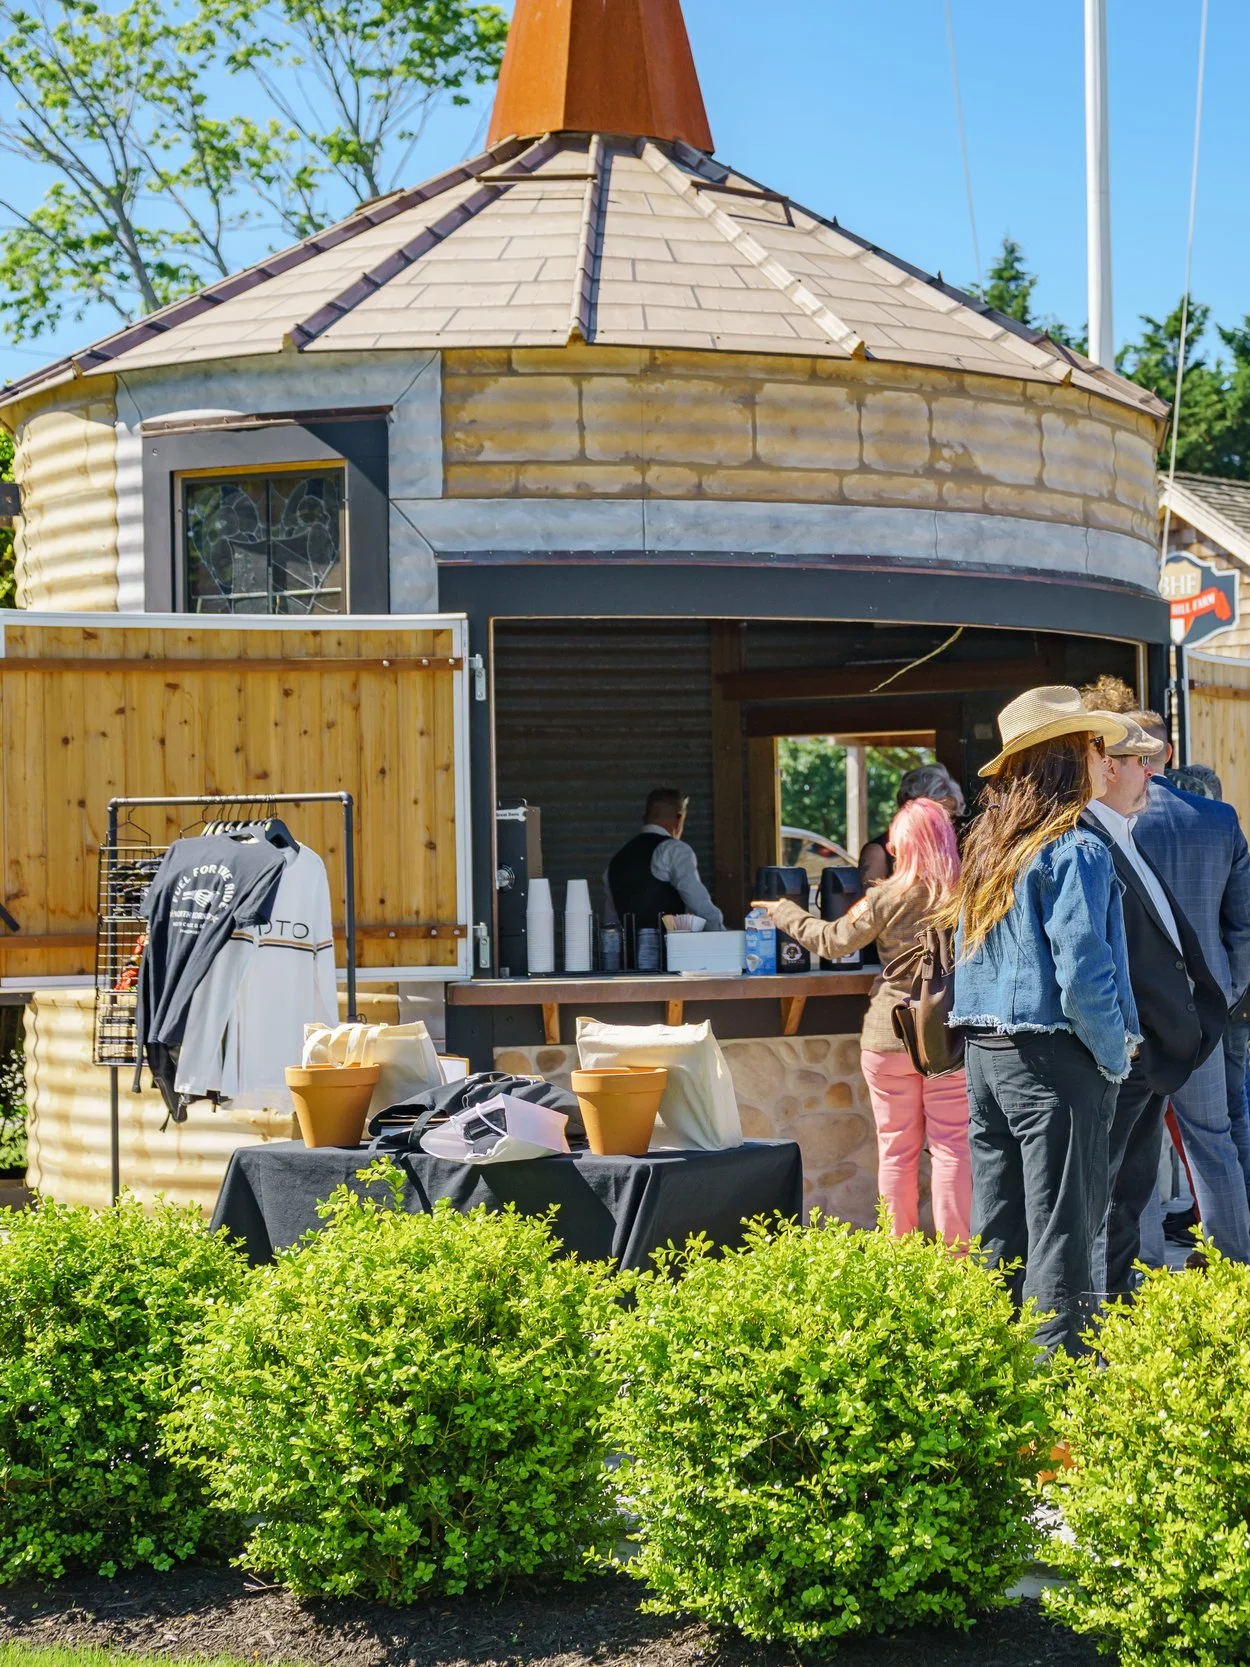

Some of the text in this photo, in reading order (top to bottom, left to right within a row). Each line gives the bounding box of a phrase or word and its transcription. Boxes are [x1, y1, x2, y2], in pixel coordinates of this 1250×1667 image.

[172, 864, 235, 909] FUEL FOR THE RIDE
